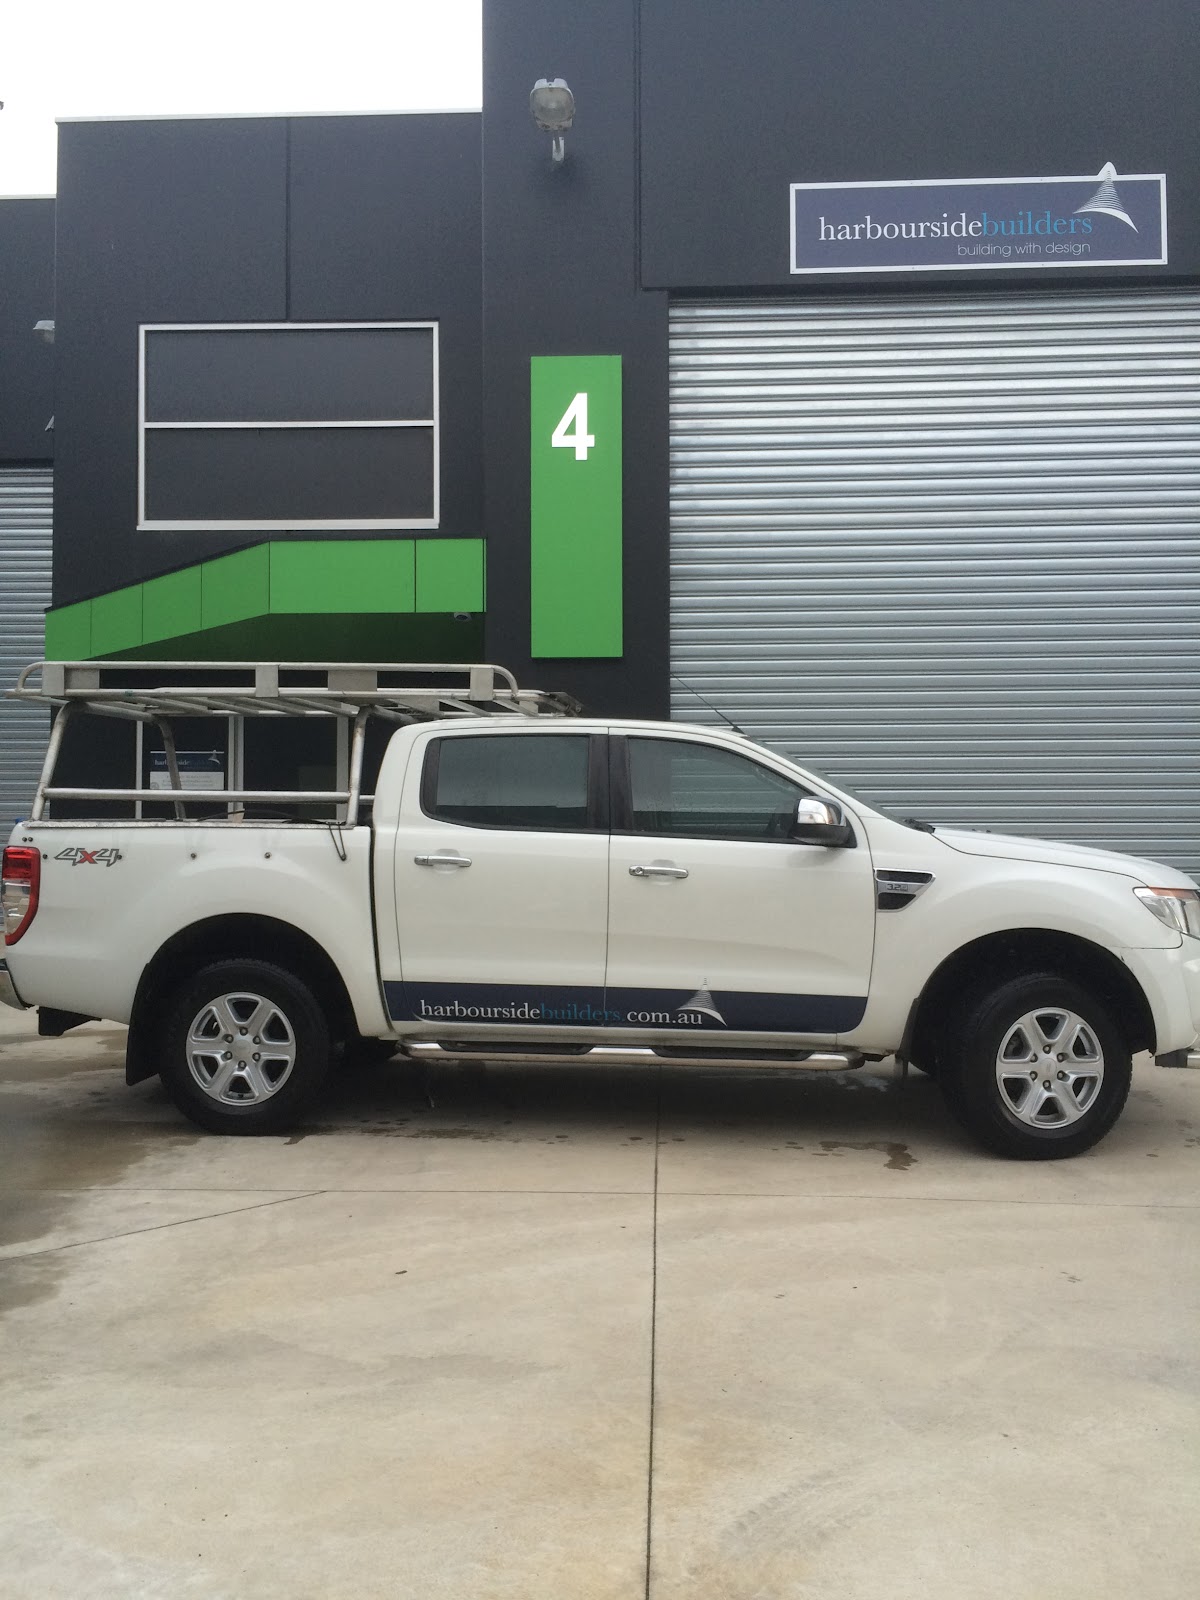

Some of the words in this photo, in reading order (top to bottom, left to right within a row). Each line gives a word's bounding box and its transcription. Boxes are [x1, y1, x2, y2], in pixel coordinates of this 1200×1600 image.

[818, 211, 1093, 241] harboursidebuilders
[957, 243, 1012, 257] building
[1014, 242, 1041, 254] with
[1044, 242, 1091, 256] design
[551, 392, 595, 461] 4
[420, 999, 703, 1025] harboursidebuilders.com.au
